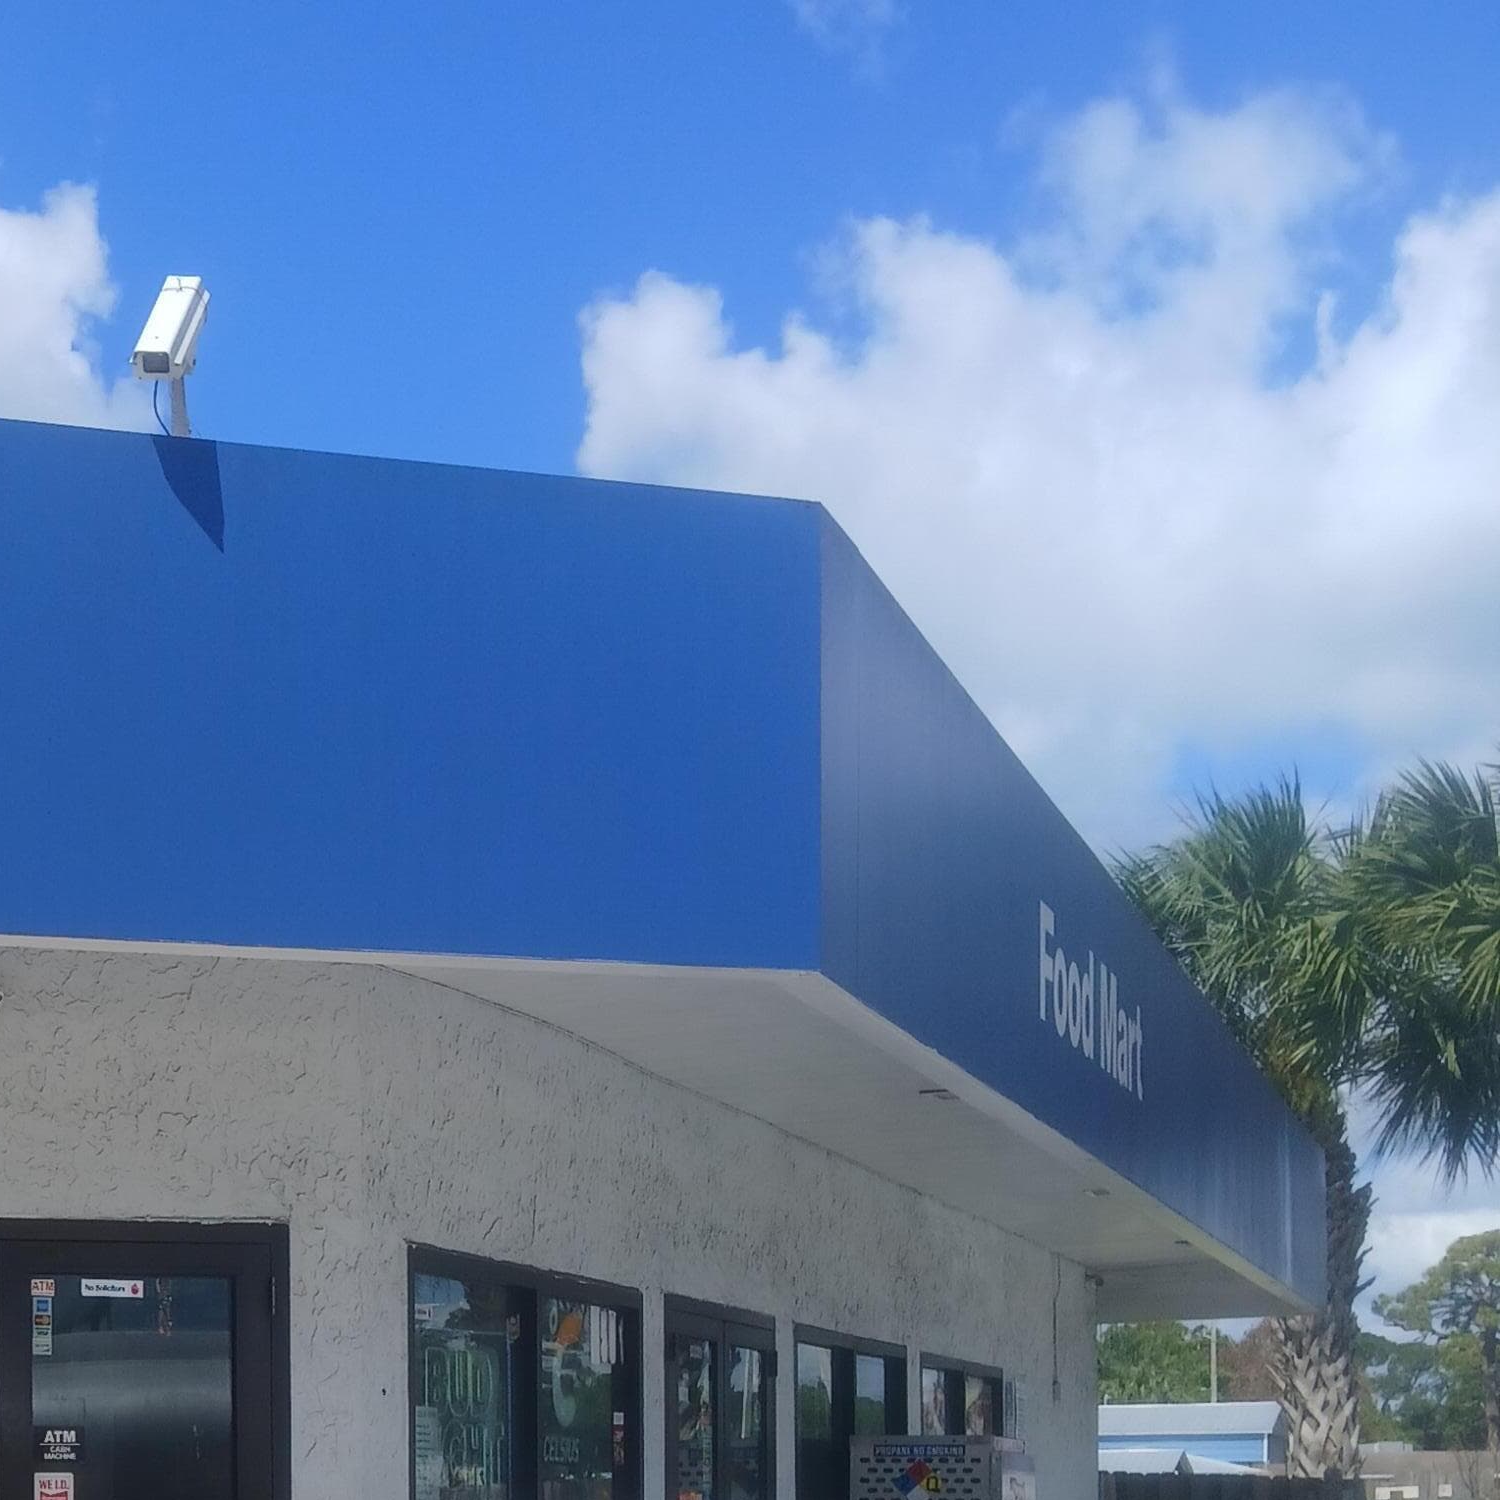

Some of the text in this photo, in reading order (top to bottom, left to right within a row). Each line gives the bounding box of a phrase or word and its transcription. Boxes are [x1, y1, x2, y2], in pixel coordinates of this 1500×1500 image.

[1040, 900, 1143, 1101] Food Mart
[32, 1281, 53, 1292] ATM
[44, 1430, 76, 1443] ATM
[543, 1435, 580, 1464] CELSIUS
[40, 1480, 54, 1489] WE
